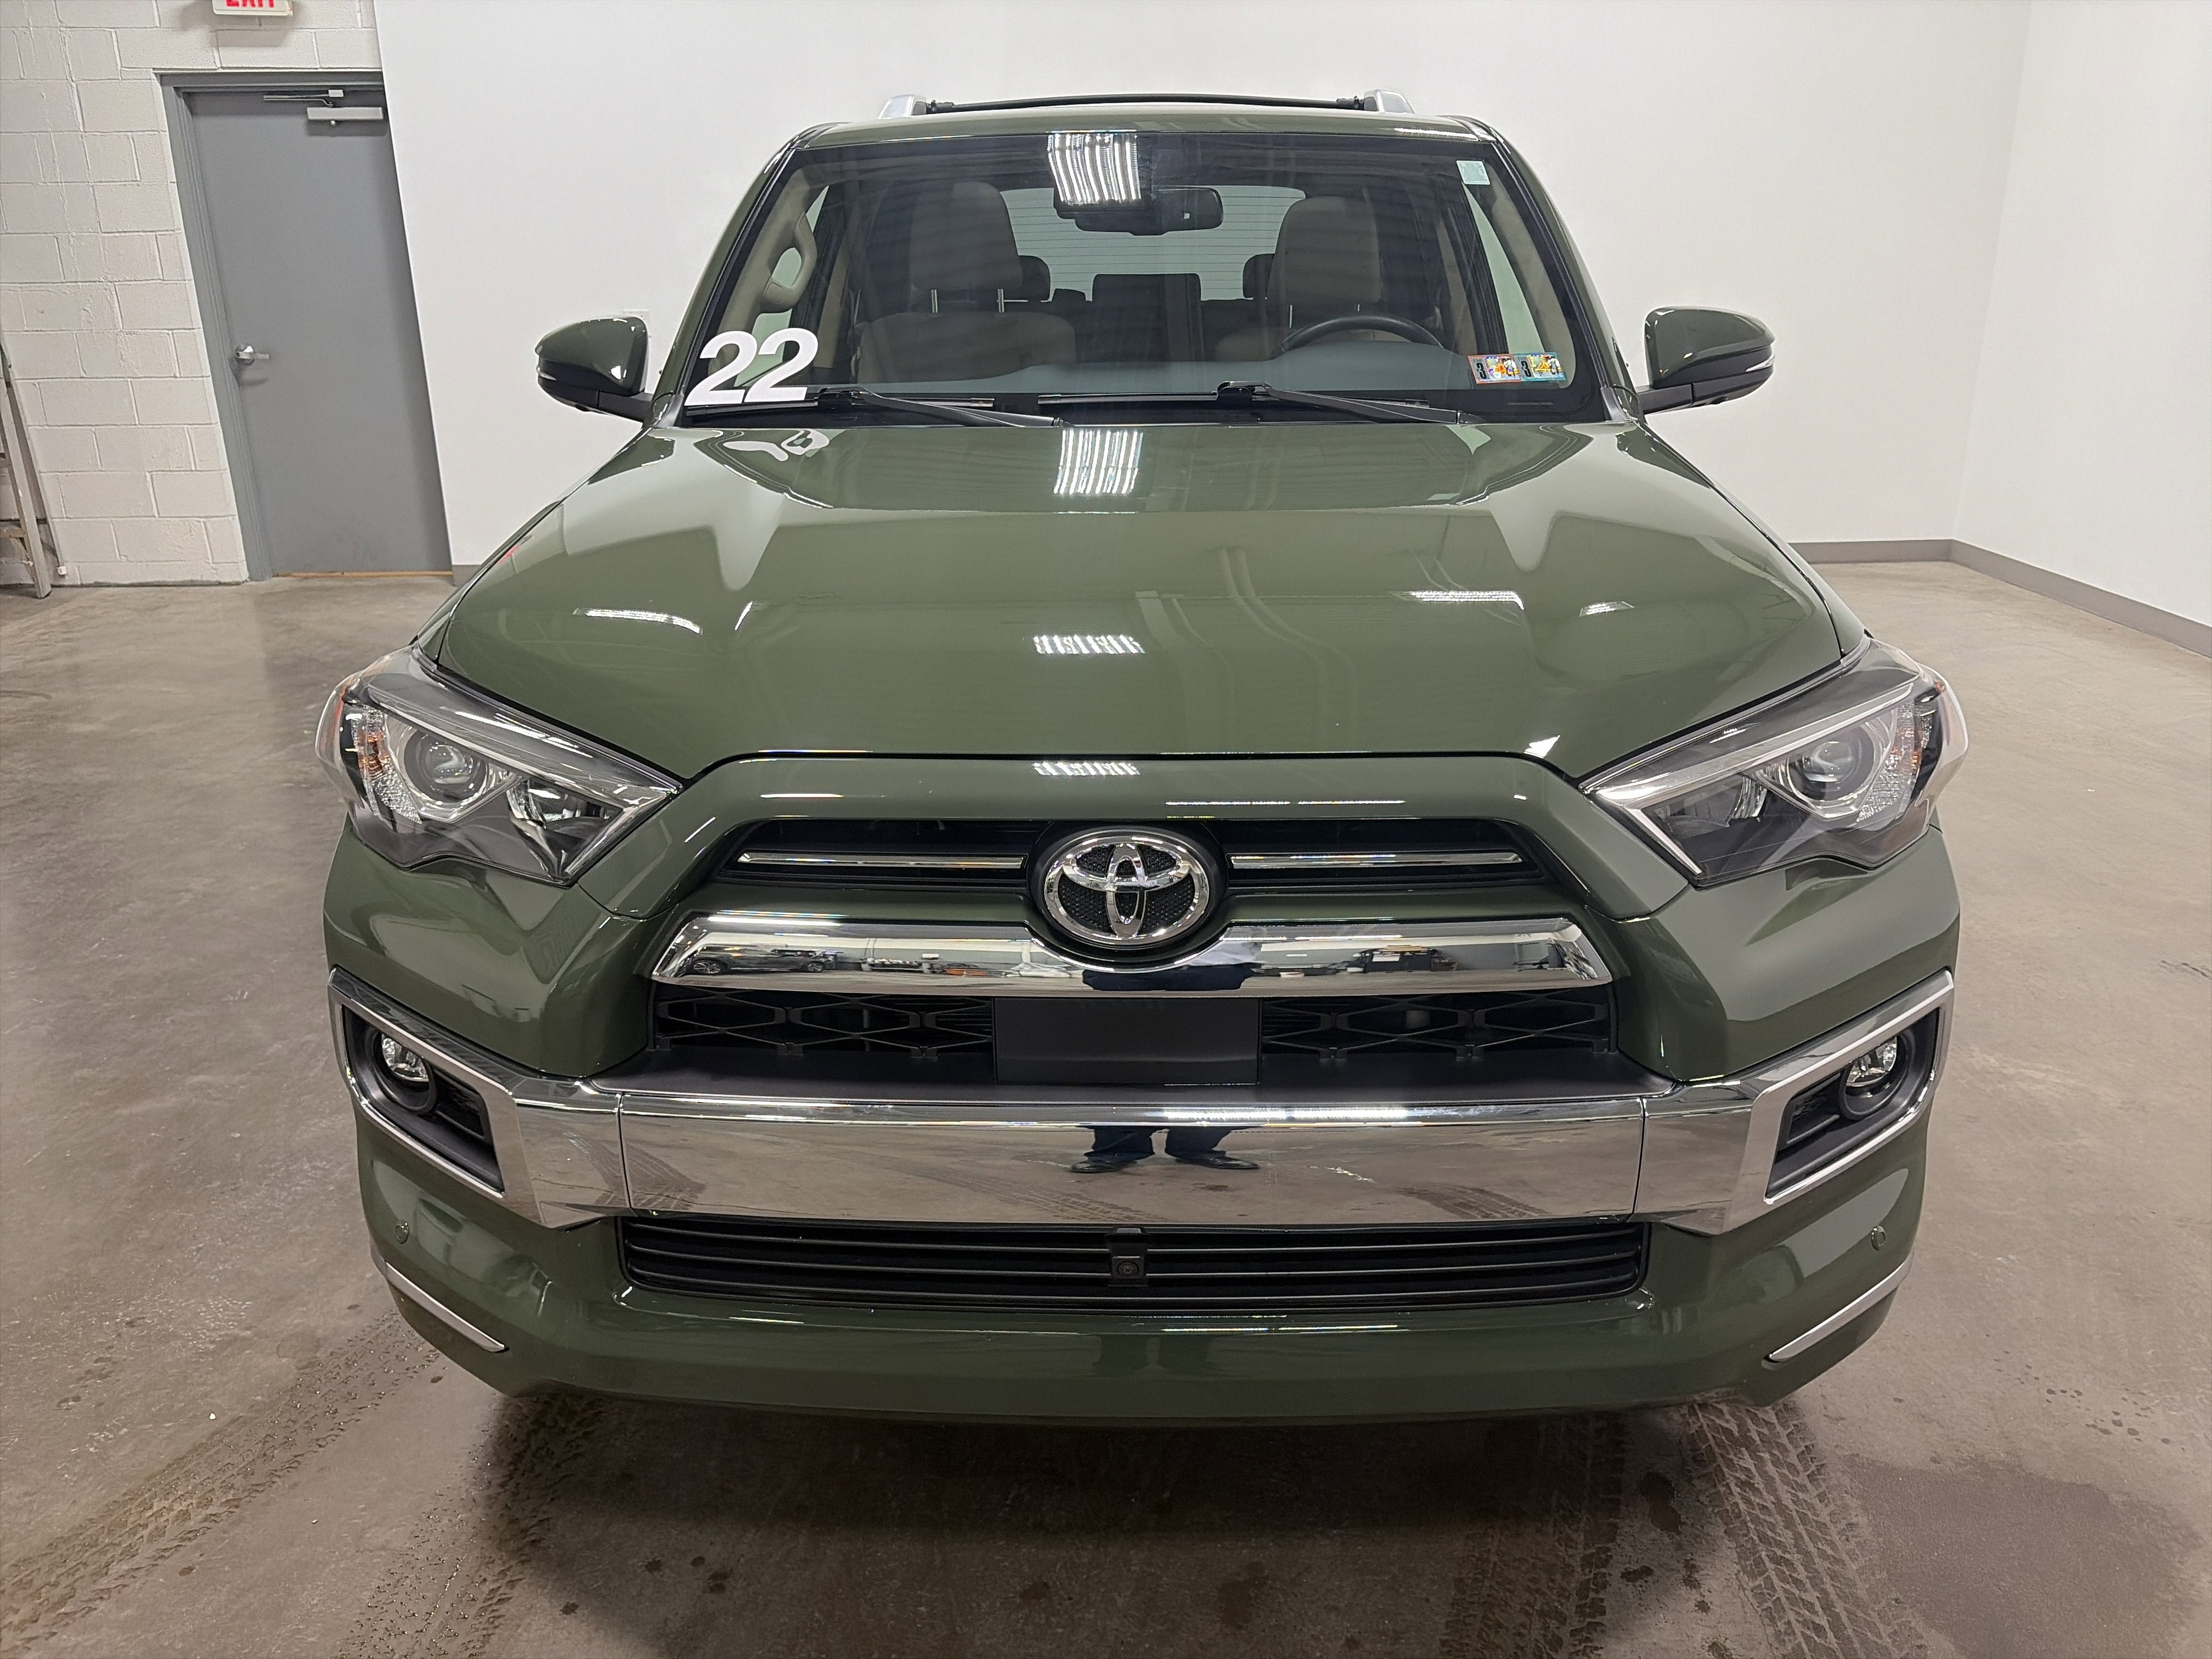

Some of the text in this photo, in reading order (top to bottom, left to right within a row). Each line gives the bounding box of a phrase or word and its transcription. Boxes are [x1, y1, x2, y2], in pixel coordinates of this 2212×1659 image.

[684, 328, 818, 406] 22
[1476, 362, 1487, 379] 3
[1521, 360, 1532, 377] 3
